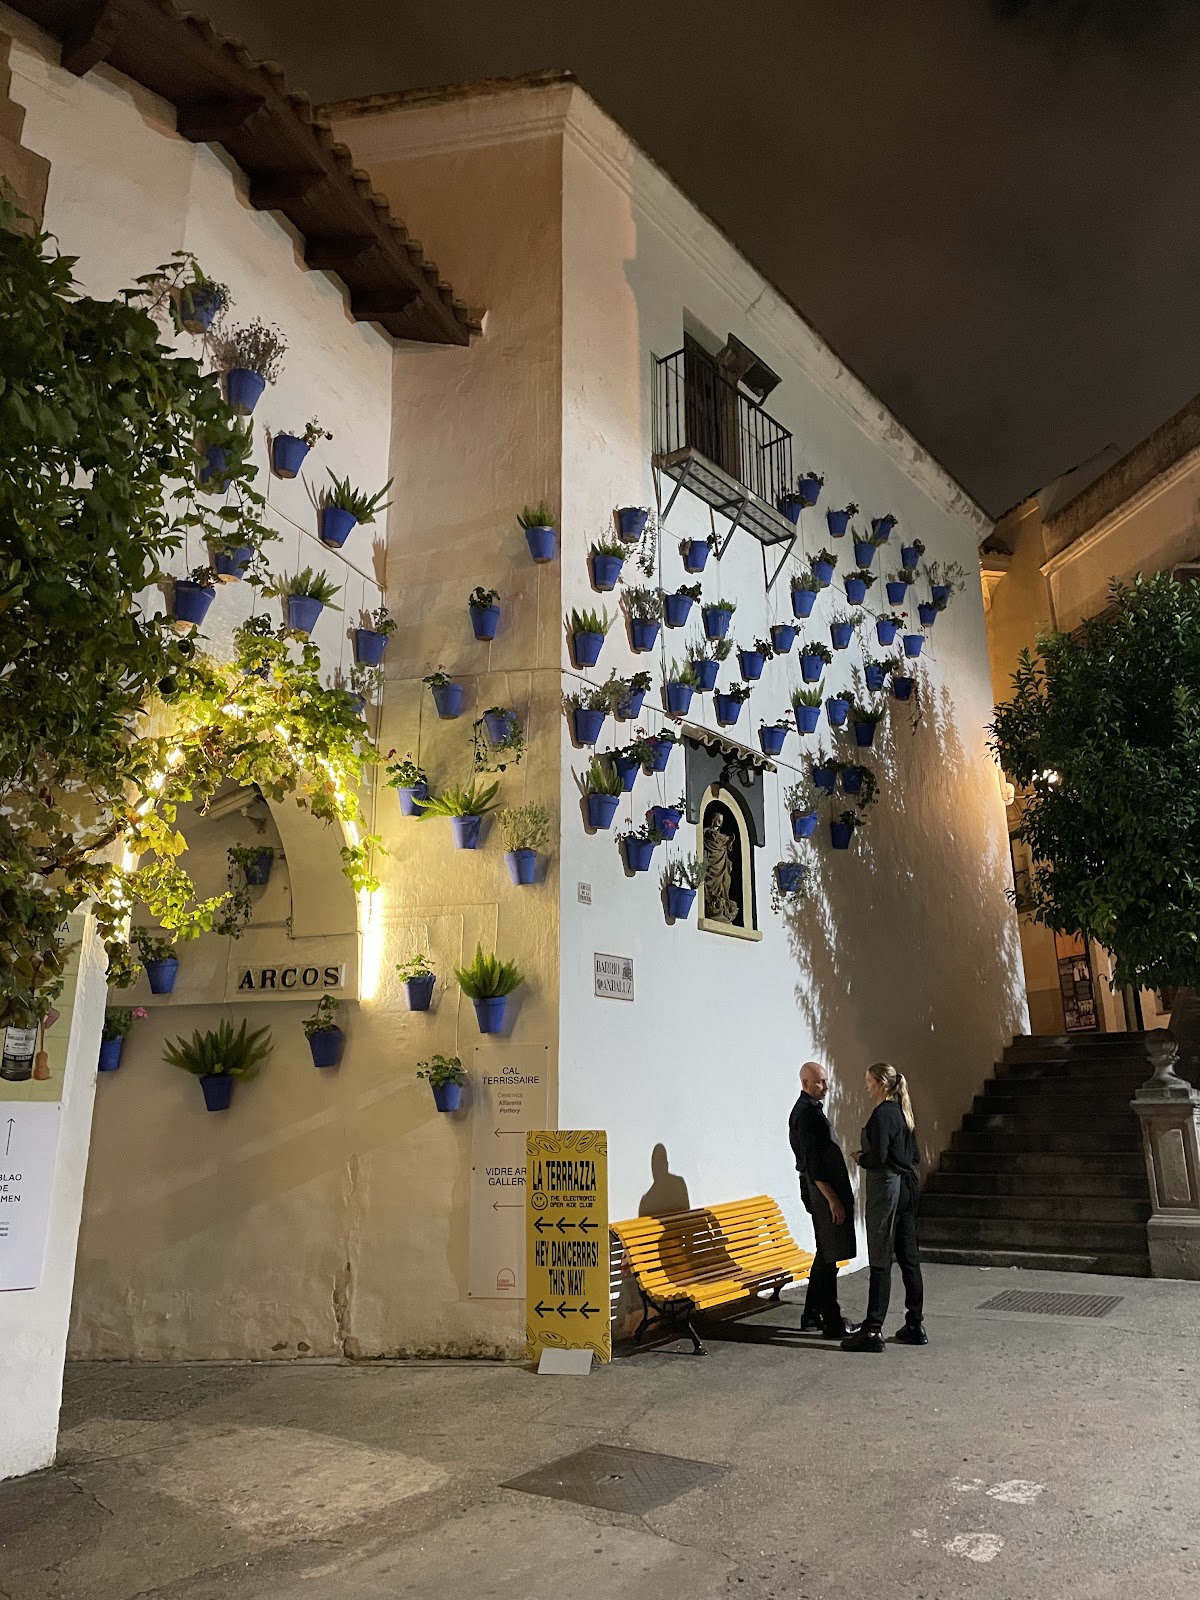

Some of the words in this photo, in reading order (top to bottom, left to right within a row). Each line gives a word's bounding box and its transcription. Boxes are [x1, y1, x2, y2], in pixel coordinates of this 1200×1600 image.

[596, 960, 620, 975] BARRIO
[238, 966, 339, 989] ARCOS
[482, 1075, 540, 1085] TERRISSAIRE
[502, 1066, 520, 1075] CAL
[485, 1167, 513, 1176] VIDRE
[532, 1160, 543, 1191] LA
[545, 1160, 597, 1191] TERRRAZZA
[535, 1240, 550, 1267] HEY
[551, 1240, 599, 1268] DANCERRRS!
[548, 1269, 565, 1296] THIS
[567, 1269, 586, 1296] WAY!
